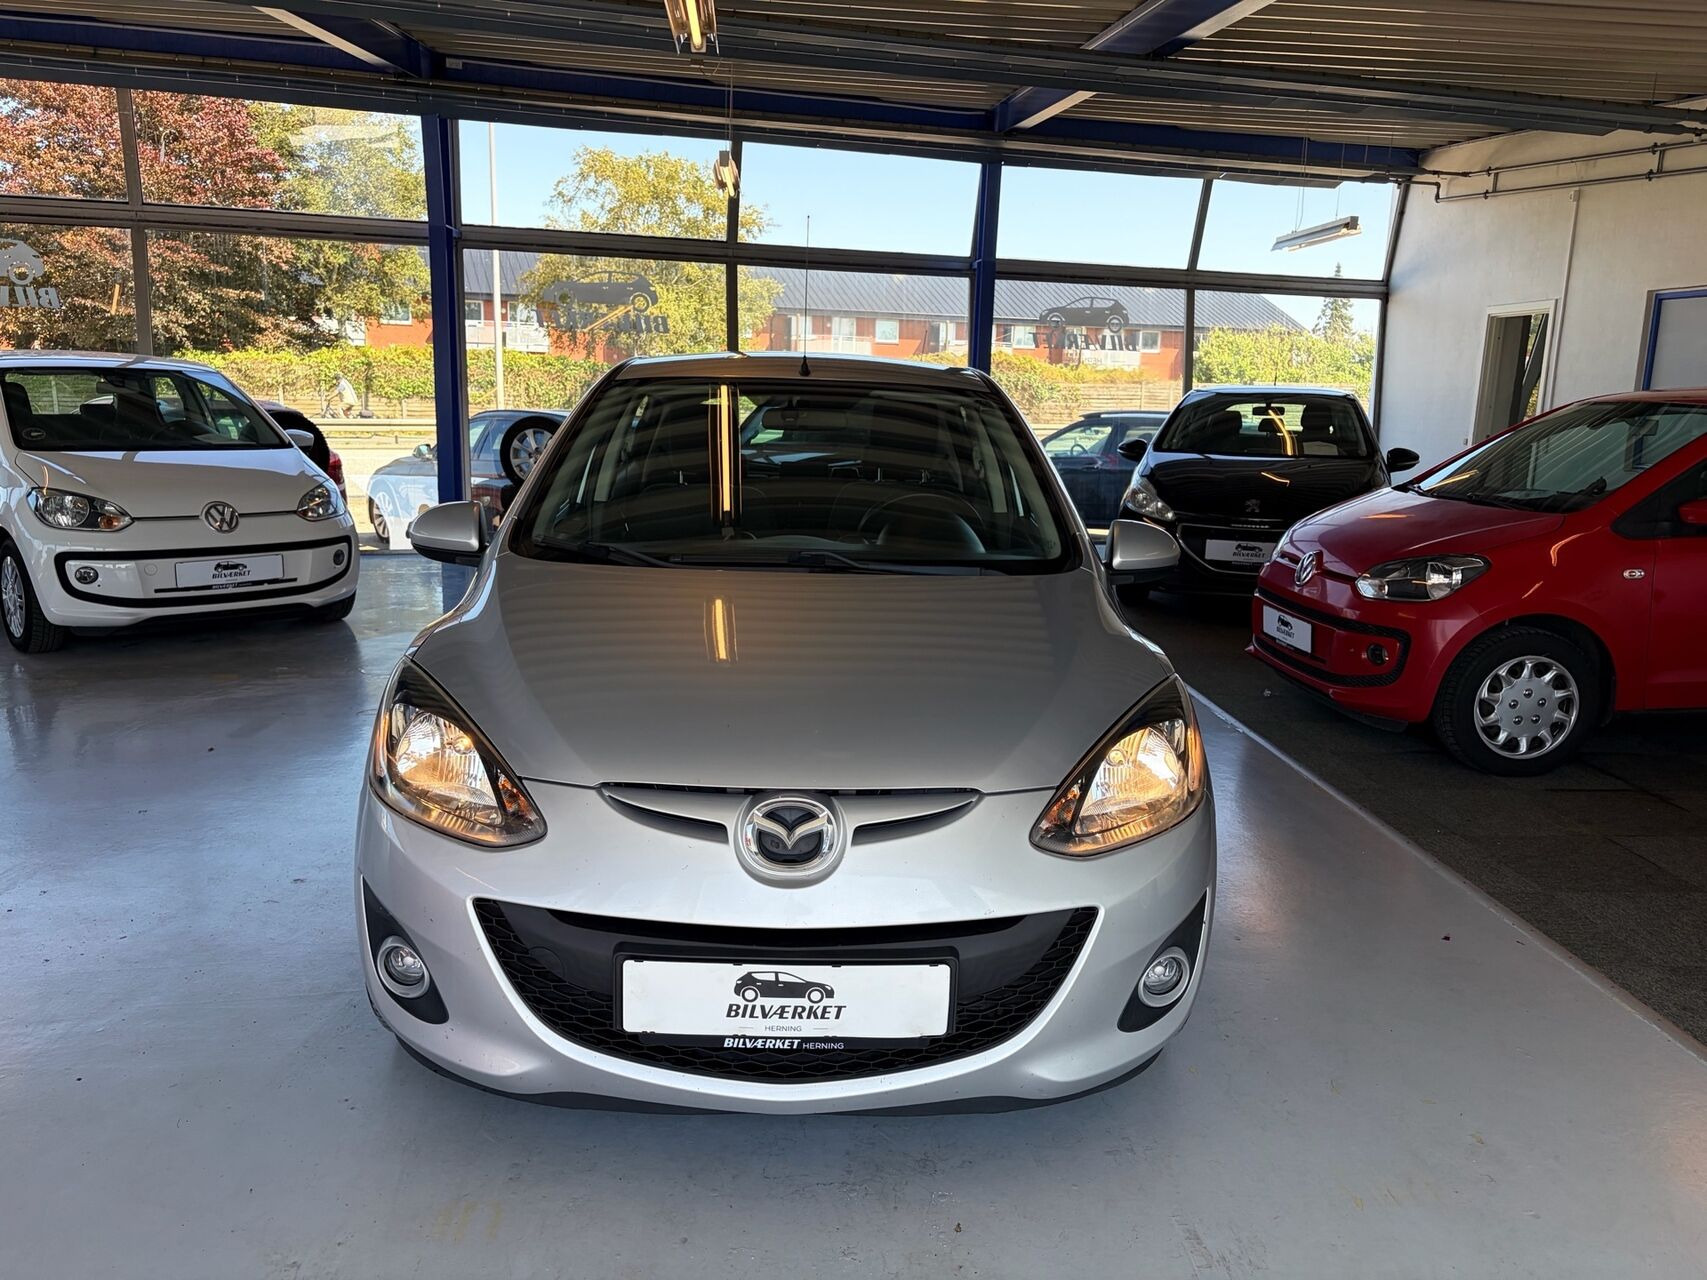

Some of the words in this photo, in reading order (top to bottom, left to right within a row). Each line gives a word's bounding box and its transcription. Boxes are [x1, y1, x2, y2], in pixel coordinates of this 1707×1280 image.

[725, 1003, 847, 1020] BILVÆRKET
[723, 1037, 801, 1049] BILVÆRKET
[802, 1042, 845, 1050] HERNING
